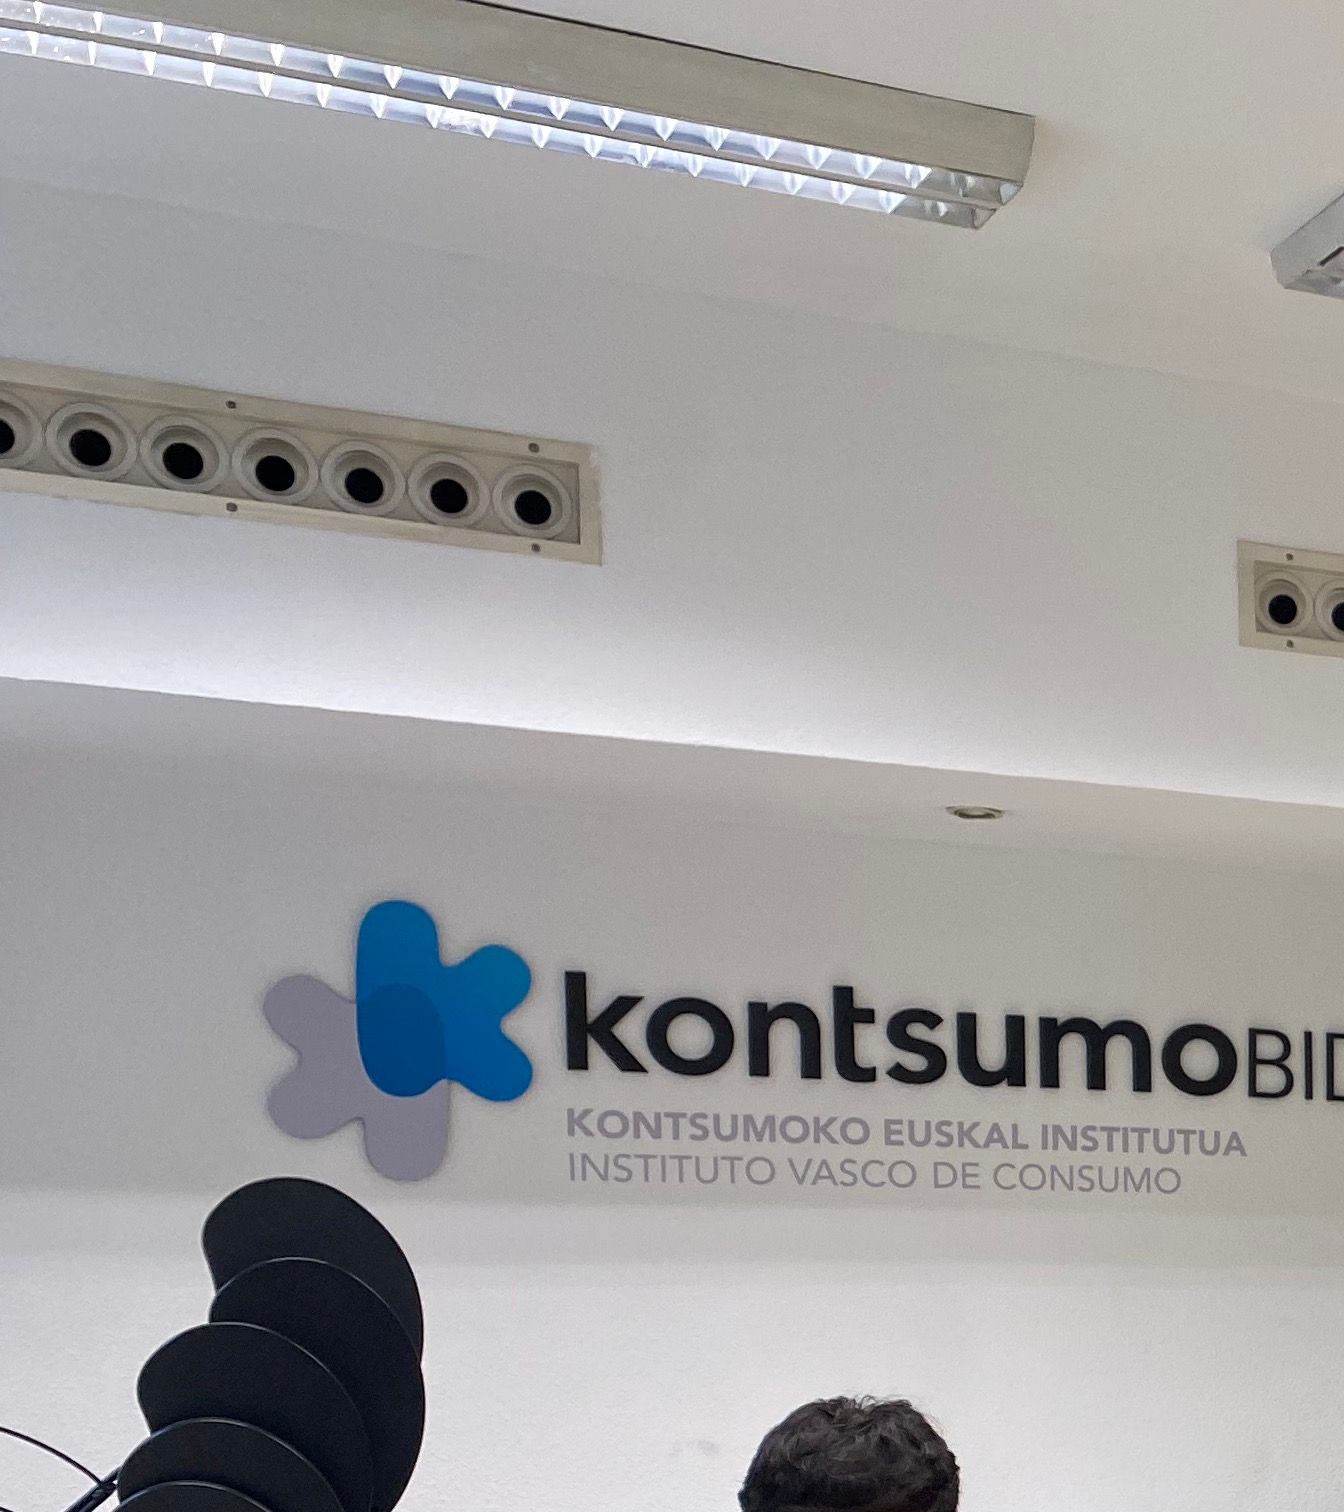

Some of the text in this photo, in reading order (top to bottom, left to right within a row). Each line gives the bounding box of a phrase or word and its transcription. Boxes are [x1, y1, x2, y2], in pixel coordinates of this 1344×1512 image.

[566, 1107, 1248, 1157] KONTSUMOKO EUSKAL INSTITUTUA
[568, 1152, 1182, 1194] INSTITUTO VASCO DE CONSUMO
